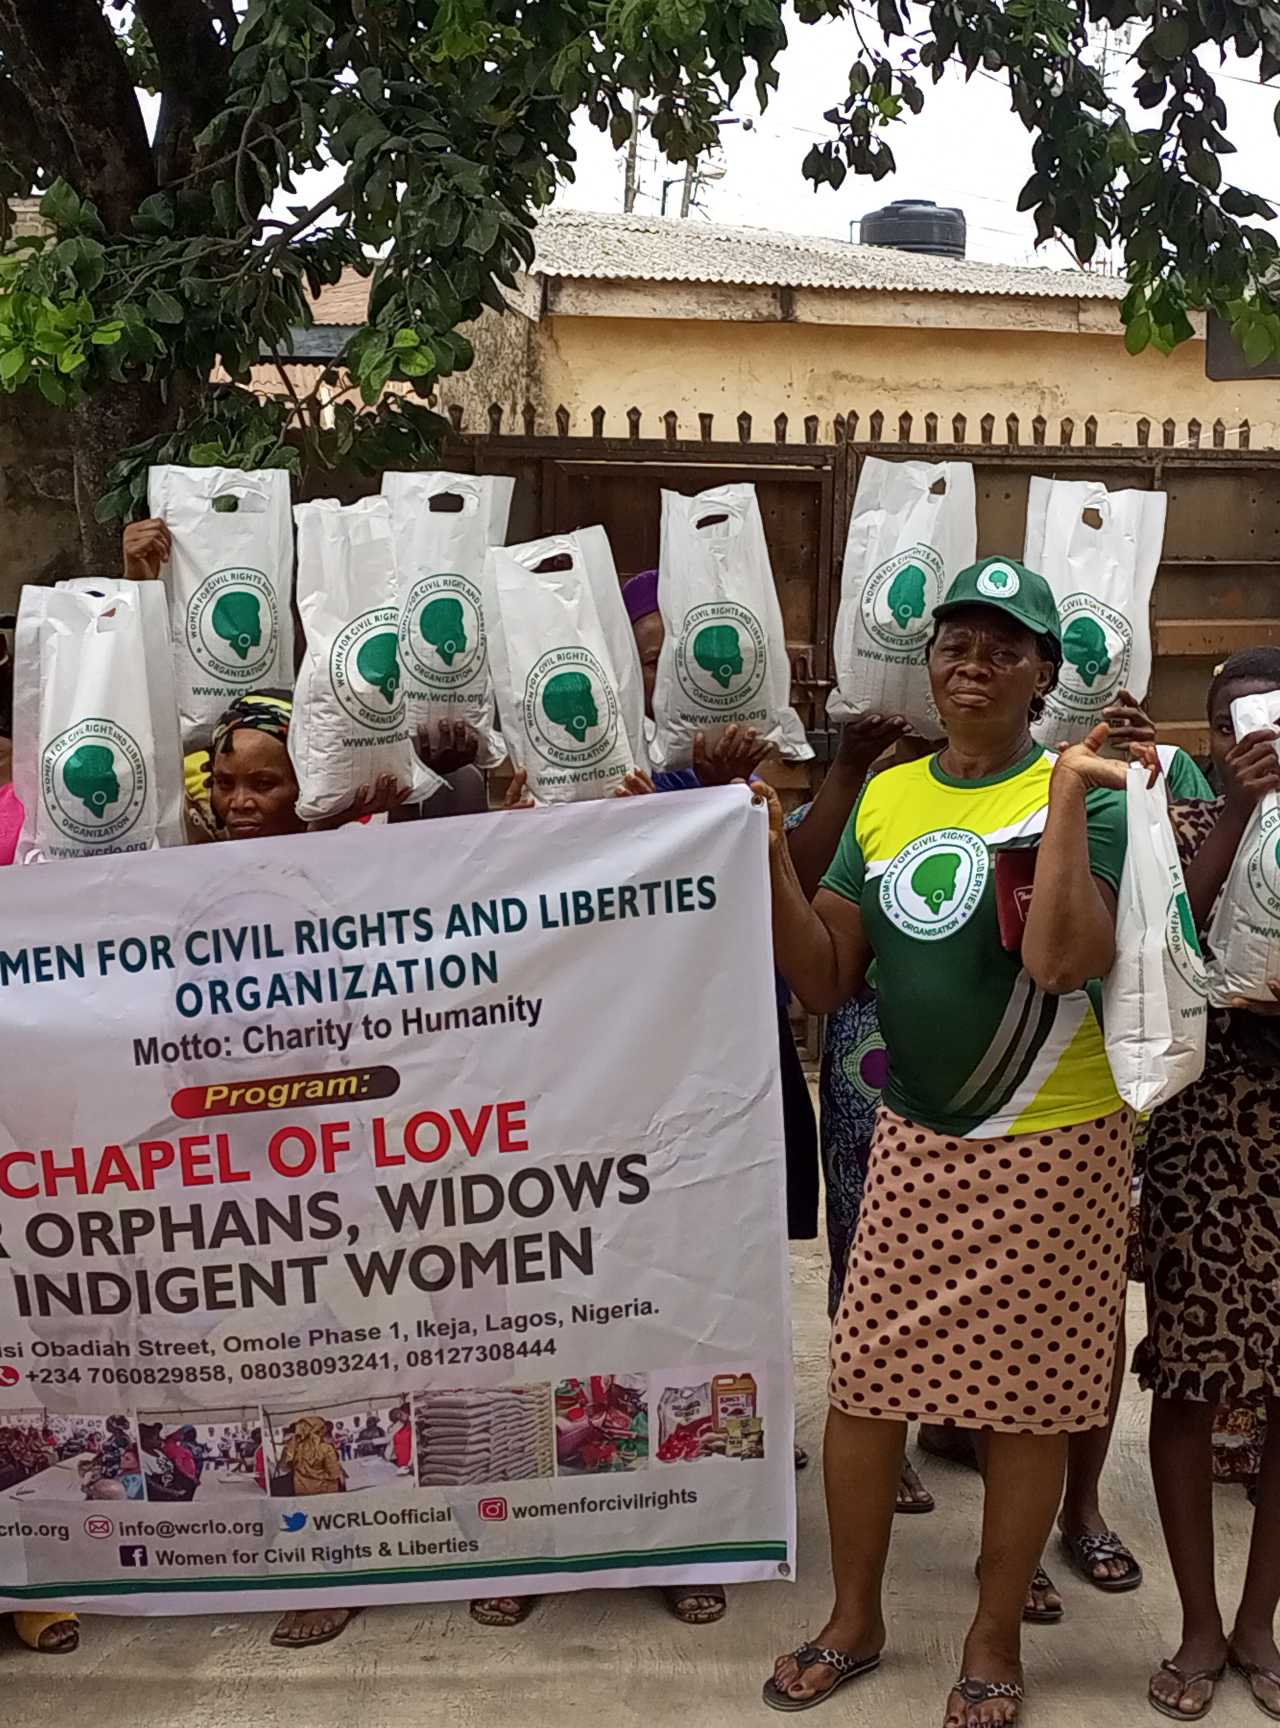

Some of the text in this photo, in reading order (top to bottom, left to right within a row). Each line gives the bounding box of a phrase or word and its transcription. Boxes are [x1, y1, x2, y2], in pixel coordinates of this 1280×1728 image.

[420, 581, 441, 594] CIVIL
[465, 586, 480, 604] AND
[864, 575, 883, 604] WOMEN
[189, 602, 201, 639] WOMEN
[208, 574, 230, 591] CIVIL
[230, 573, 262, 584] RIGHTS
[1062, 599, 1084, 613] CIVIL
[1106, 613, 1124, 629] AND
[351, 619, 372, 635] CIVIL
[691, 607, 764, 664] CIVIL RIGHTS AND LIBERTIES
[857, 648, 927, 666] www.wcrlo.o
[414, 664, 473, 684] ORGANIZATION
[526, 652, 589, 728] WOMEN FOR CIVIL RIGHTS
[692, 687, 753, 705] ORGANIZATION
[1059, 688, 1113, 704] RGANIZATION
[680, 709, 767, 723] www.wcrlo.org
[52, 739, 68, 757] FOR
[126, 744, 144, 791] LIBERTIES
[547, 739, 611, 762] ORGANIZATION
[61, 815, 130, 838] ORGANIZATION
[882, 871, 895, 911] WOMEN
[893, 850, 911, 869] FOR
[912, 835, 937, 851] CIVIL
[940, 831, 973, 844] RIGHTS
[963, 857, 985, 911] LIBERTIES
[97, 934, 176, 977] FOR
[184, 923, 284, 967] CIVIL
[294, 907, 434, 955] RIGHTS
[445, 897, 529, 940] AND
[539, 875, 718, 929] LIBERTIES
[901, 917, 960, 937] ORGANISATION
[1171, 911, 1180, 953] WOMEN
[175, 950, 499, 1018] ORGANIZATION
[133, 995, 543, 1067] Motto: Charity to Humanity
[203, 1071, 372, 1110] Program:
[267, 1120, 351, 1178] OF
[372, 1100, 529, 1168] LOVE
[25, 1190, 360, 1259] ORPHANS,
[375, 1153, 651, 1234] WIDOWS
[14, 1256, 328, 1317] INDIGENT
[344, 1226, 595, 1298] WOMEN
[30, 1340, 131, 1359] Obadiah
[138, 1338, 217, 1359] Street,
[223, 1331, 301, 1354] Omole
[309, 1324, 381, 1347] Phase
[388, 1322, 409, 1343] 1,
[416, 1316, 478, 1341] Ikeja,
[485, 1309, 564, 1335] Lagos,
[571, 1298, 660, 1325] Nigeria.
[25, 1338, 557, 1385] +234 7060829858, 08038093241, 08127308444
[312, 1506, 452, 1531] WCRLOofficial
[512, 1488, 698, 1520] womenforcivilrights
[119, 1519, 264, 1538] info@wcrlo.org
[156, 1537, 479, 1567] Women for Civil Rights & Liberties
